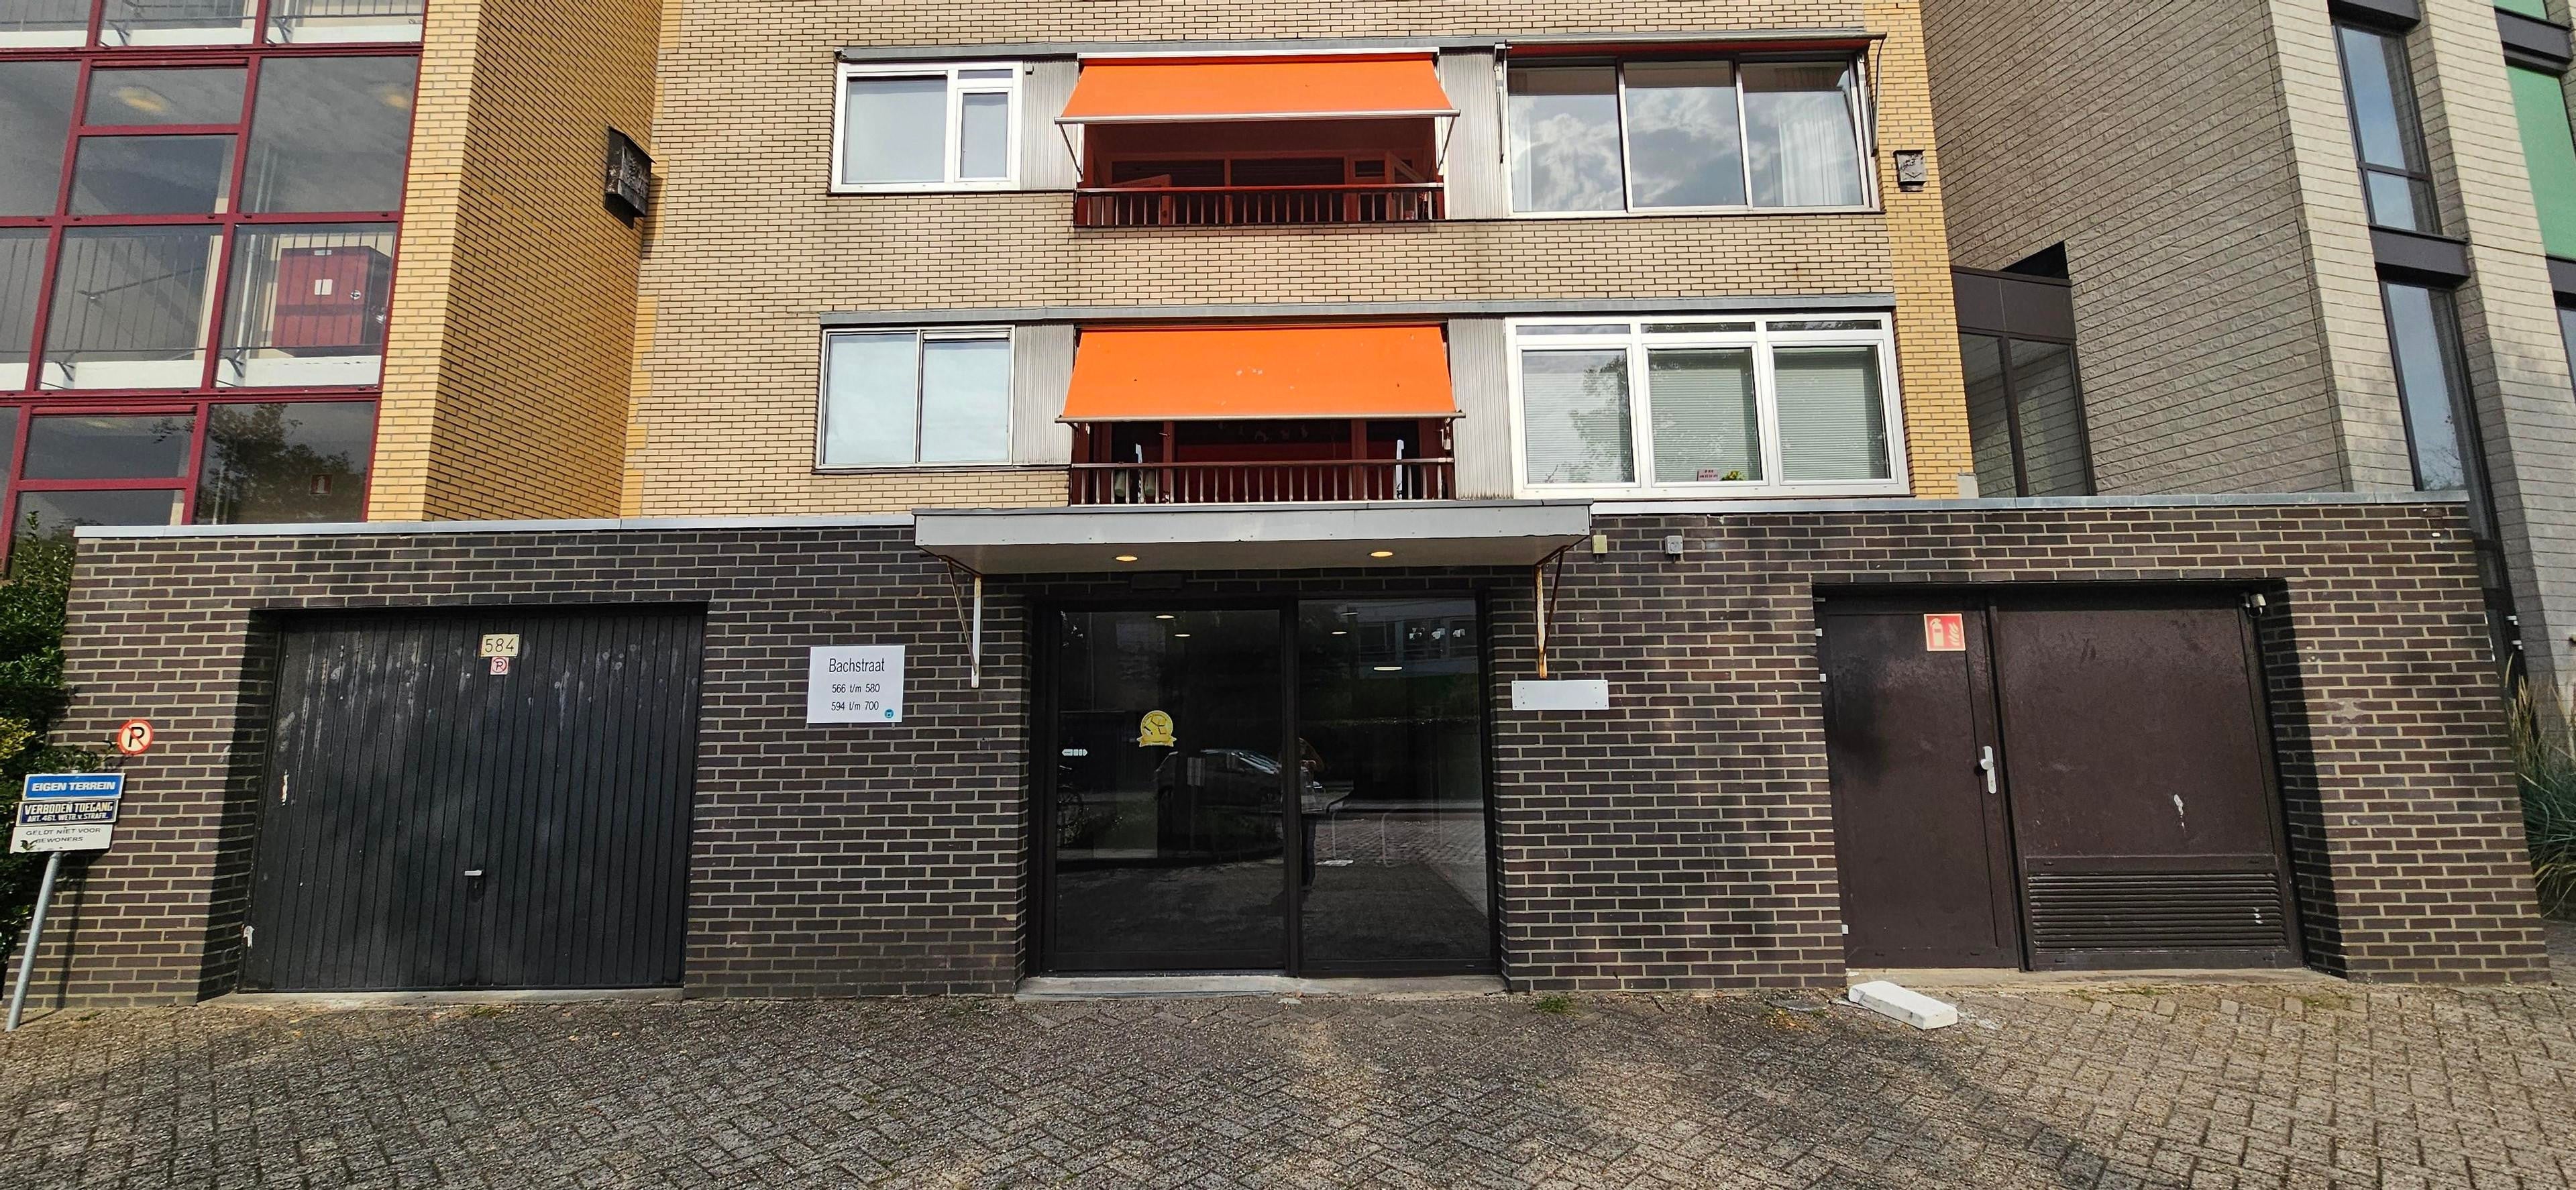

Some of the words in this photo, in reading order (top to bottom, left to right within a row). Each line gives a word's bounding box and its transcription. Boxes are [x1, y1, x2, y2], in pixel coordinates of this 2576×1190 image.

[484, 638, 515, 653] 584
[828, 657, 885, 673] Bachstraat
[832, 684, 847, 694] 566
[850, 684, 862, 693] t/m
[865, 683, 880, 693] 580
[831, 701, 845, 711] 594
[849, 701, 861, 711] t/m
[865, 701, 879, 710] 700
[32, 782, 67, 792] EIGEN
[68, 781, 116, 791] TERREIN
[25, 803, 72, 815] VERBODEN
[74, 802, 113, 812] TOEGANG
